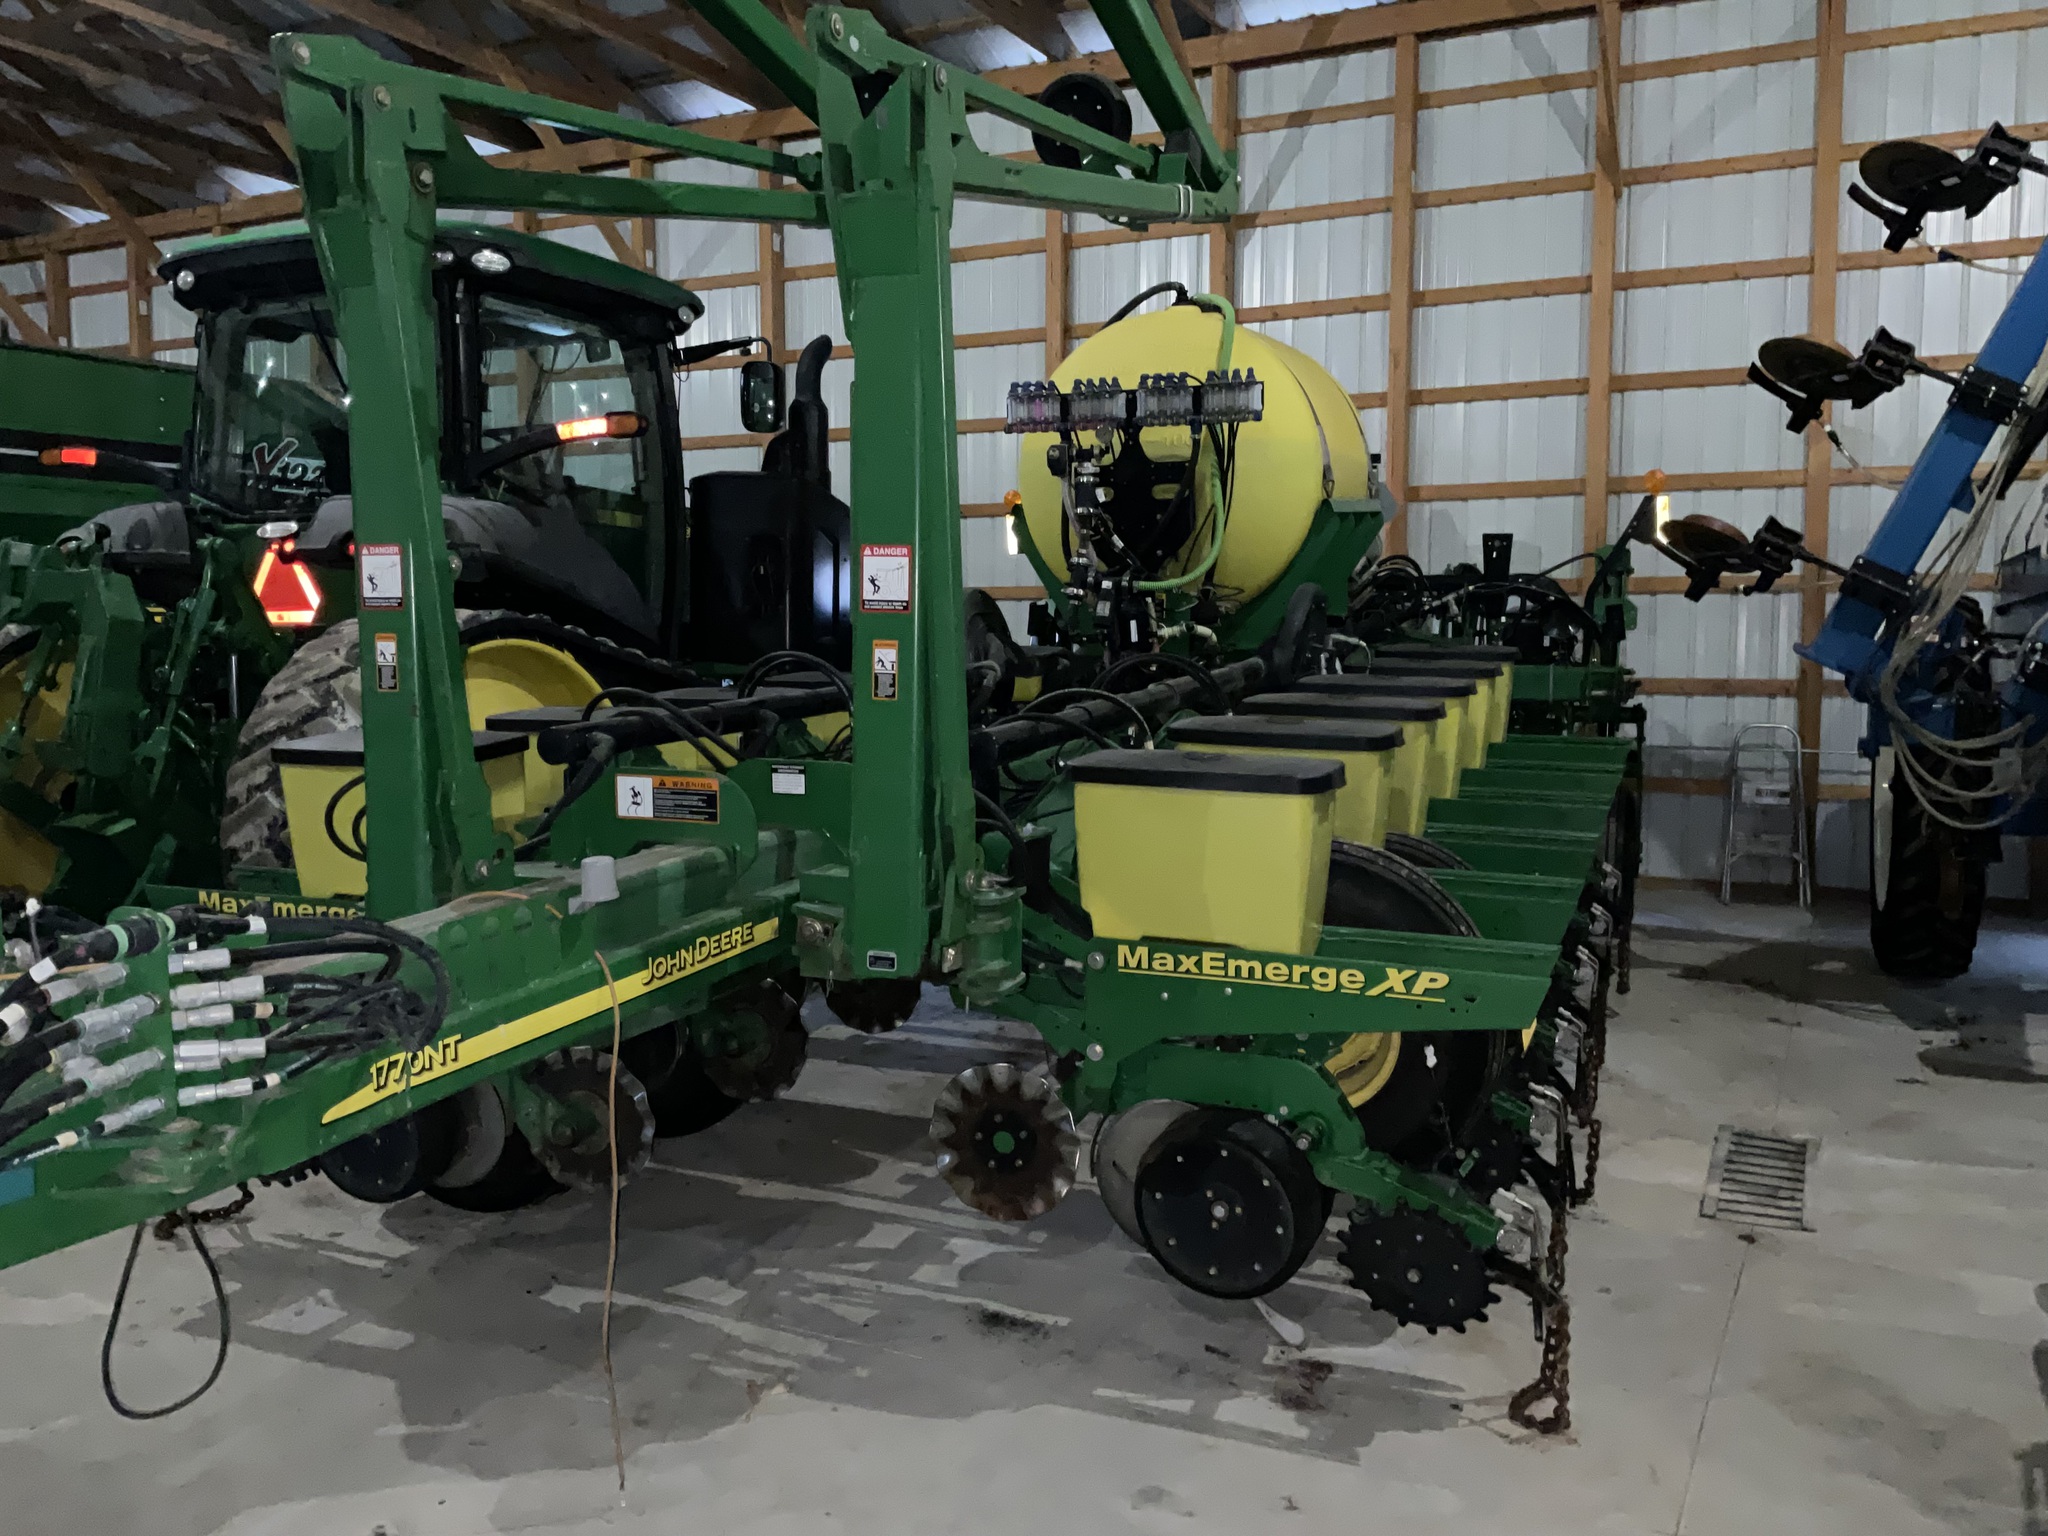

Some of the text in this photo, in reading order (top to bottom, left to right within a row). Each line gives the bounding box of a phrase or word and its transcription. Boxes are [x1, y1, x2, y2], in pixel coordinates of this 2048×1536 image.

[369, 546, 400, 555] DANGER
[873, 546, 908, 556] DANGER
[671, 780, 713, 789] WARNING
[198, 889, 361, 921] Maxmerge
[640, 921, 755, 986] JOHN DEERE
[1117, 944, 1450, 997] MaxEmerge XP
[369, 1033, 463, 1092] 1770NT
